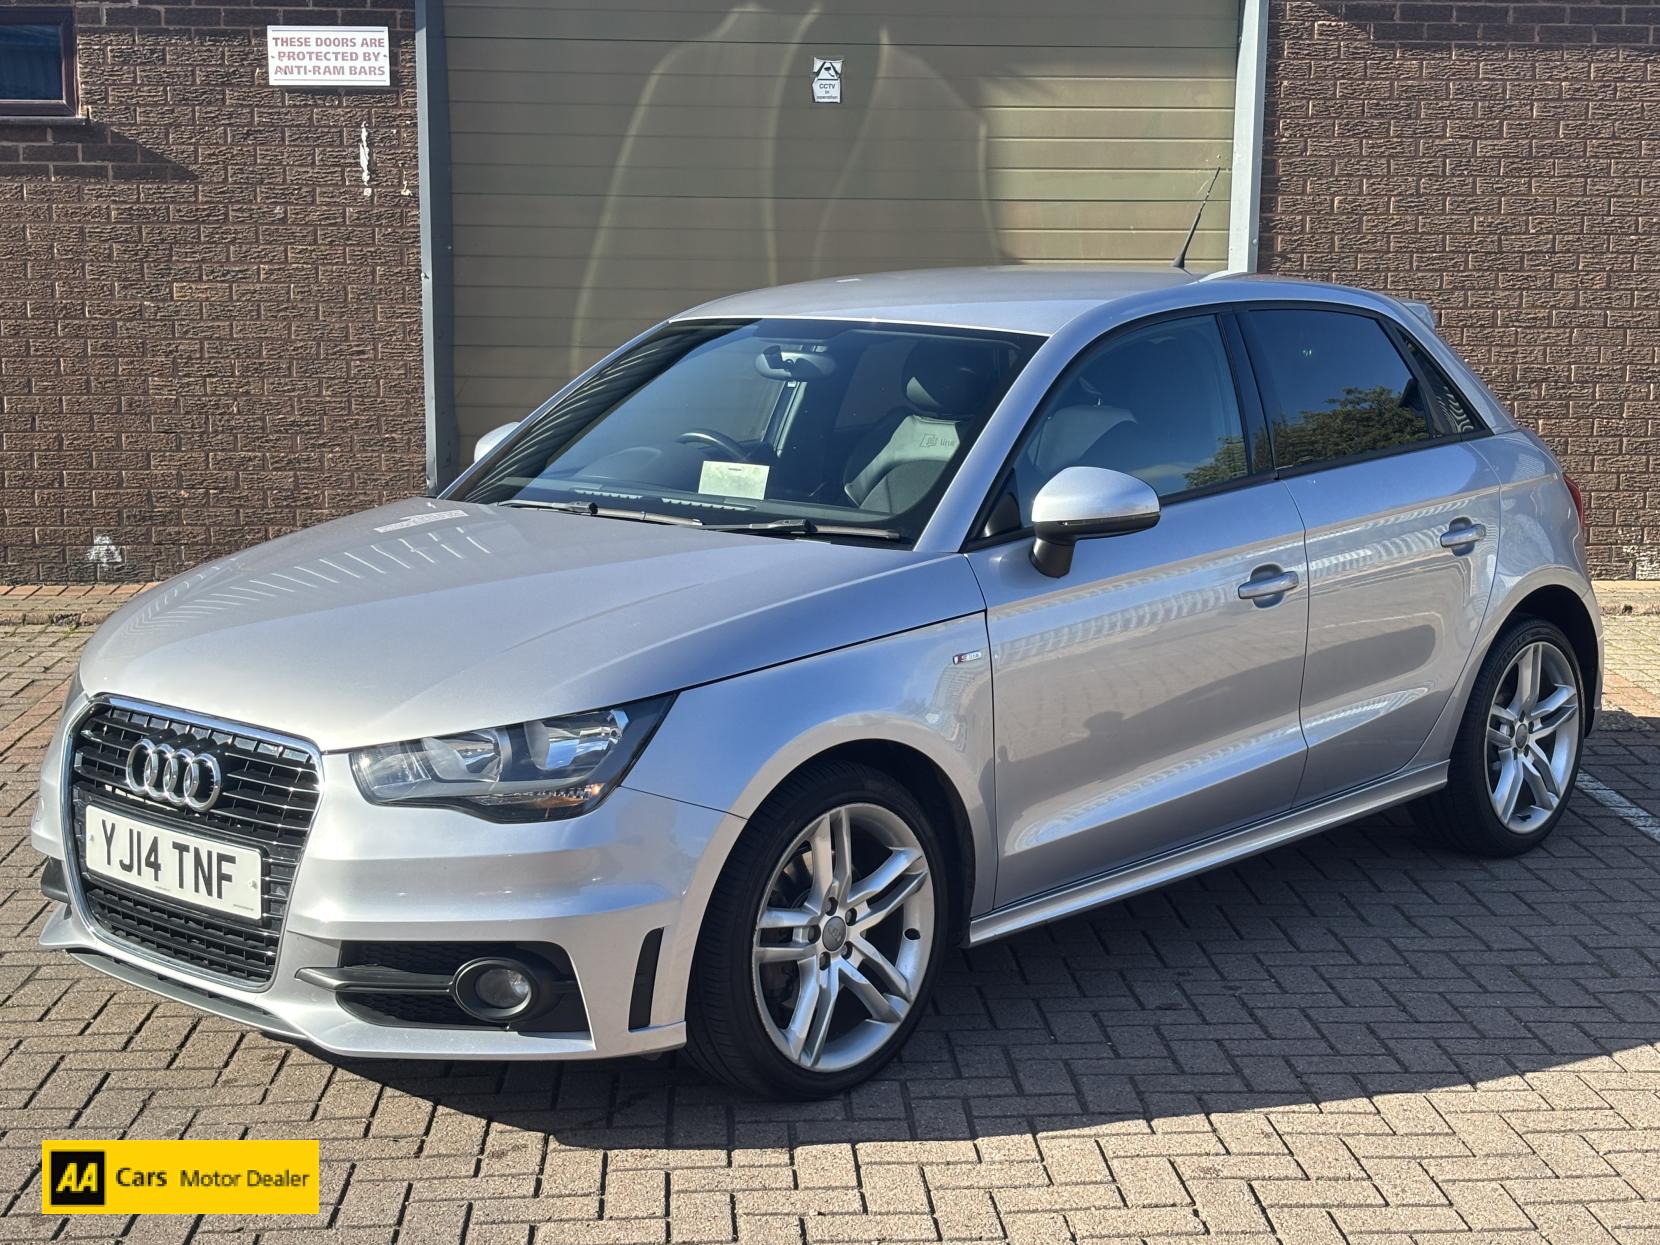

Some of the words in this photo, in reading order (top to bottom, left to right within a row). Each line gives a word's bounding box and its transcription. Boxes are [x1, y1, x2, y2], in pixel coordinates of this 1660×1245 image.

[272, 37, 311, 47] THESE
[315, 37, 357, 48] DOORS
[360, 37, 385, 48] ARE
[277, 51, 359, 62] PROTECTED
[362, 51, 381, 62] BY
[274, 65, 345, 76] ANTI-RAM
[349, 65, 386, 76] BARS
[101, 819, 162, 882] YJ14
[172, 840, 237, 900] TNF
